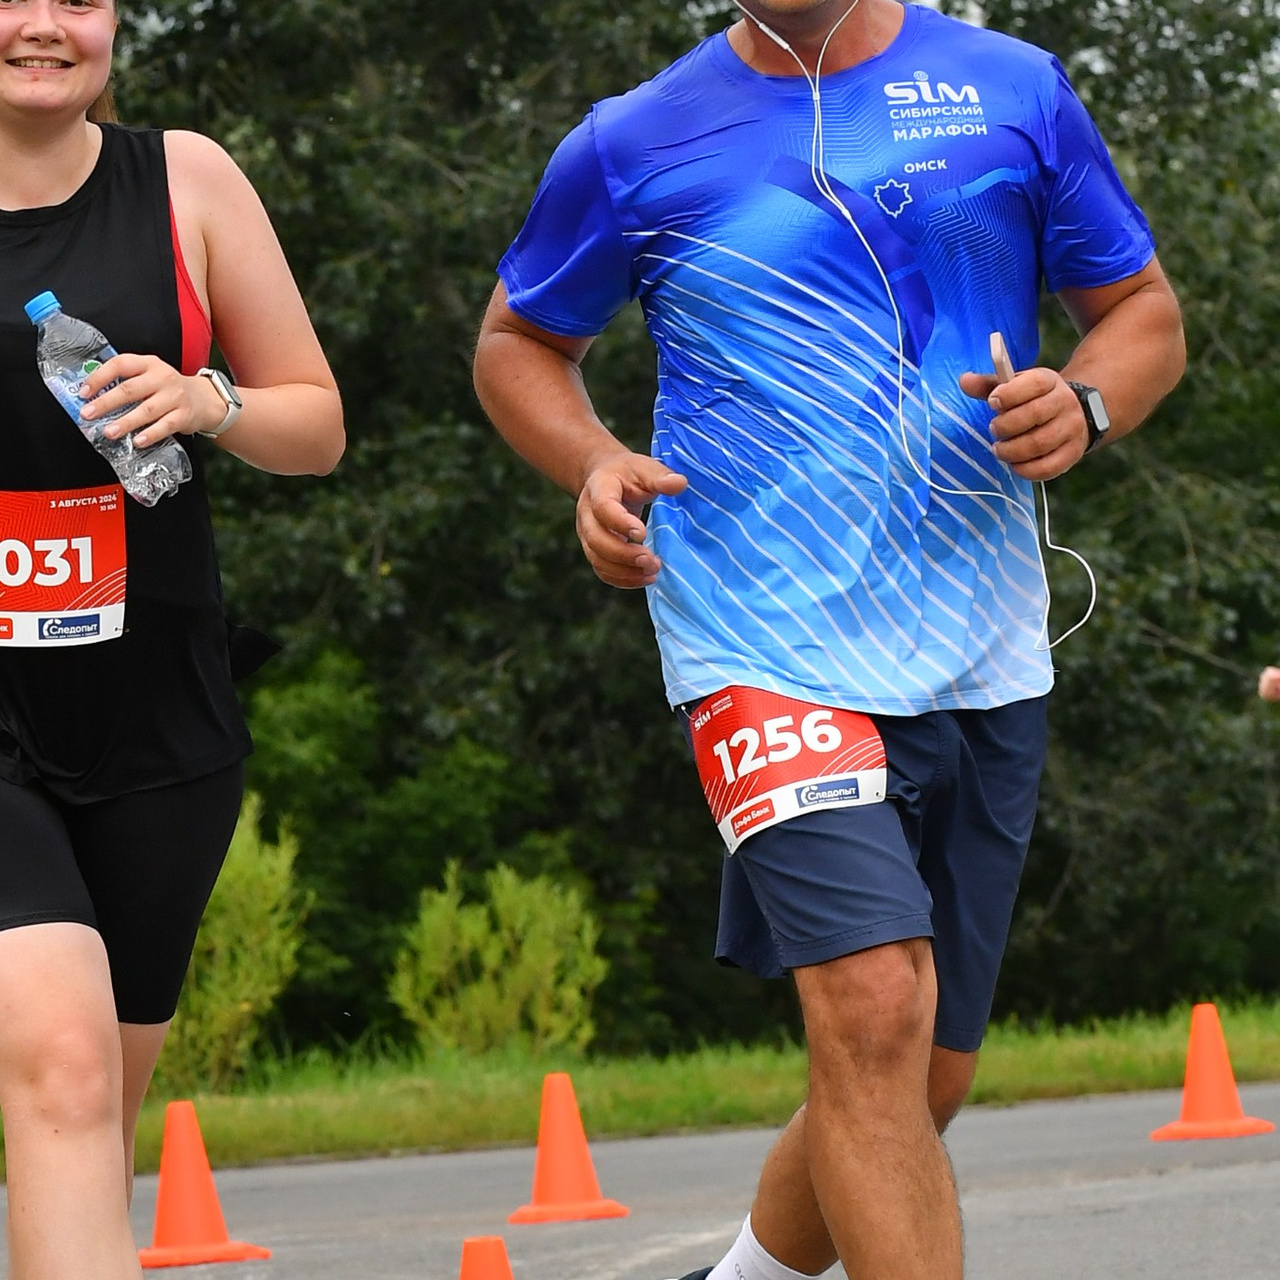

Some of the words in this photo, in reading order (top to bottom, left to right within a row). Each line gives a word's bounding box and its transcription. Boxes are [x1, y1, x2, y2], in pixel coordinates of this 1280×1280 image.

[889, 104, 983, 119] СИБИРСКИЙ
[893, 124, 988, 142] МАРАФОН
[904, 159, 947, 173] ОМСК
[50, 500, 56, 508] 3
[58, 497, 98, 508] АВГУСТА
[49, 623, 98, 635] Следопыт
[712, 710, 842, 785] 1256
[807, 787, 857, 801] Следопыт
